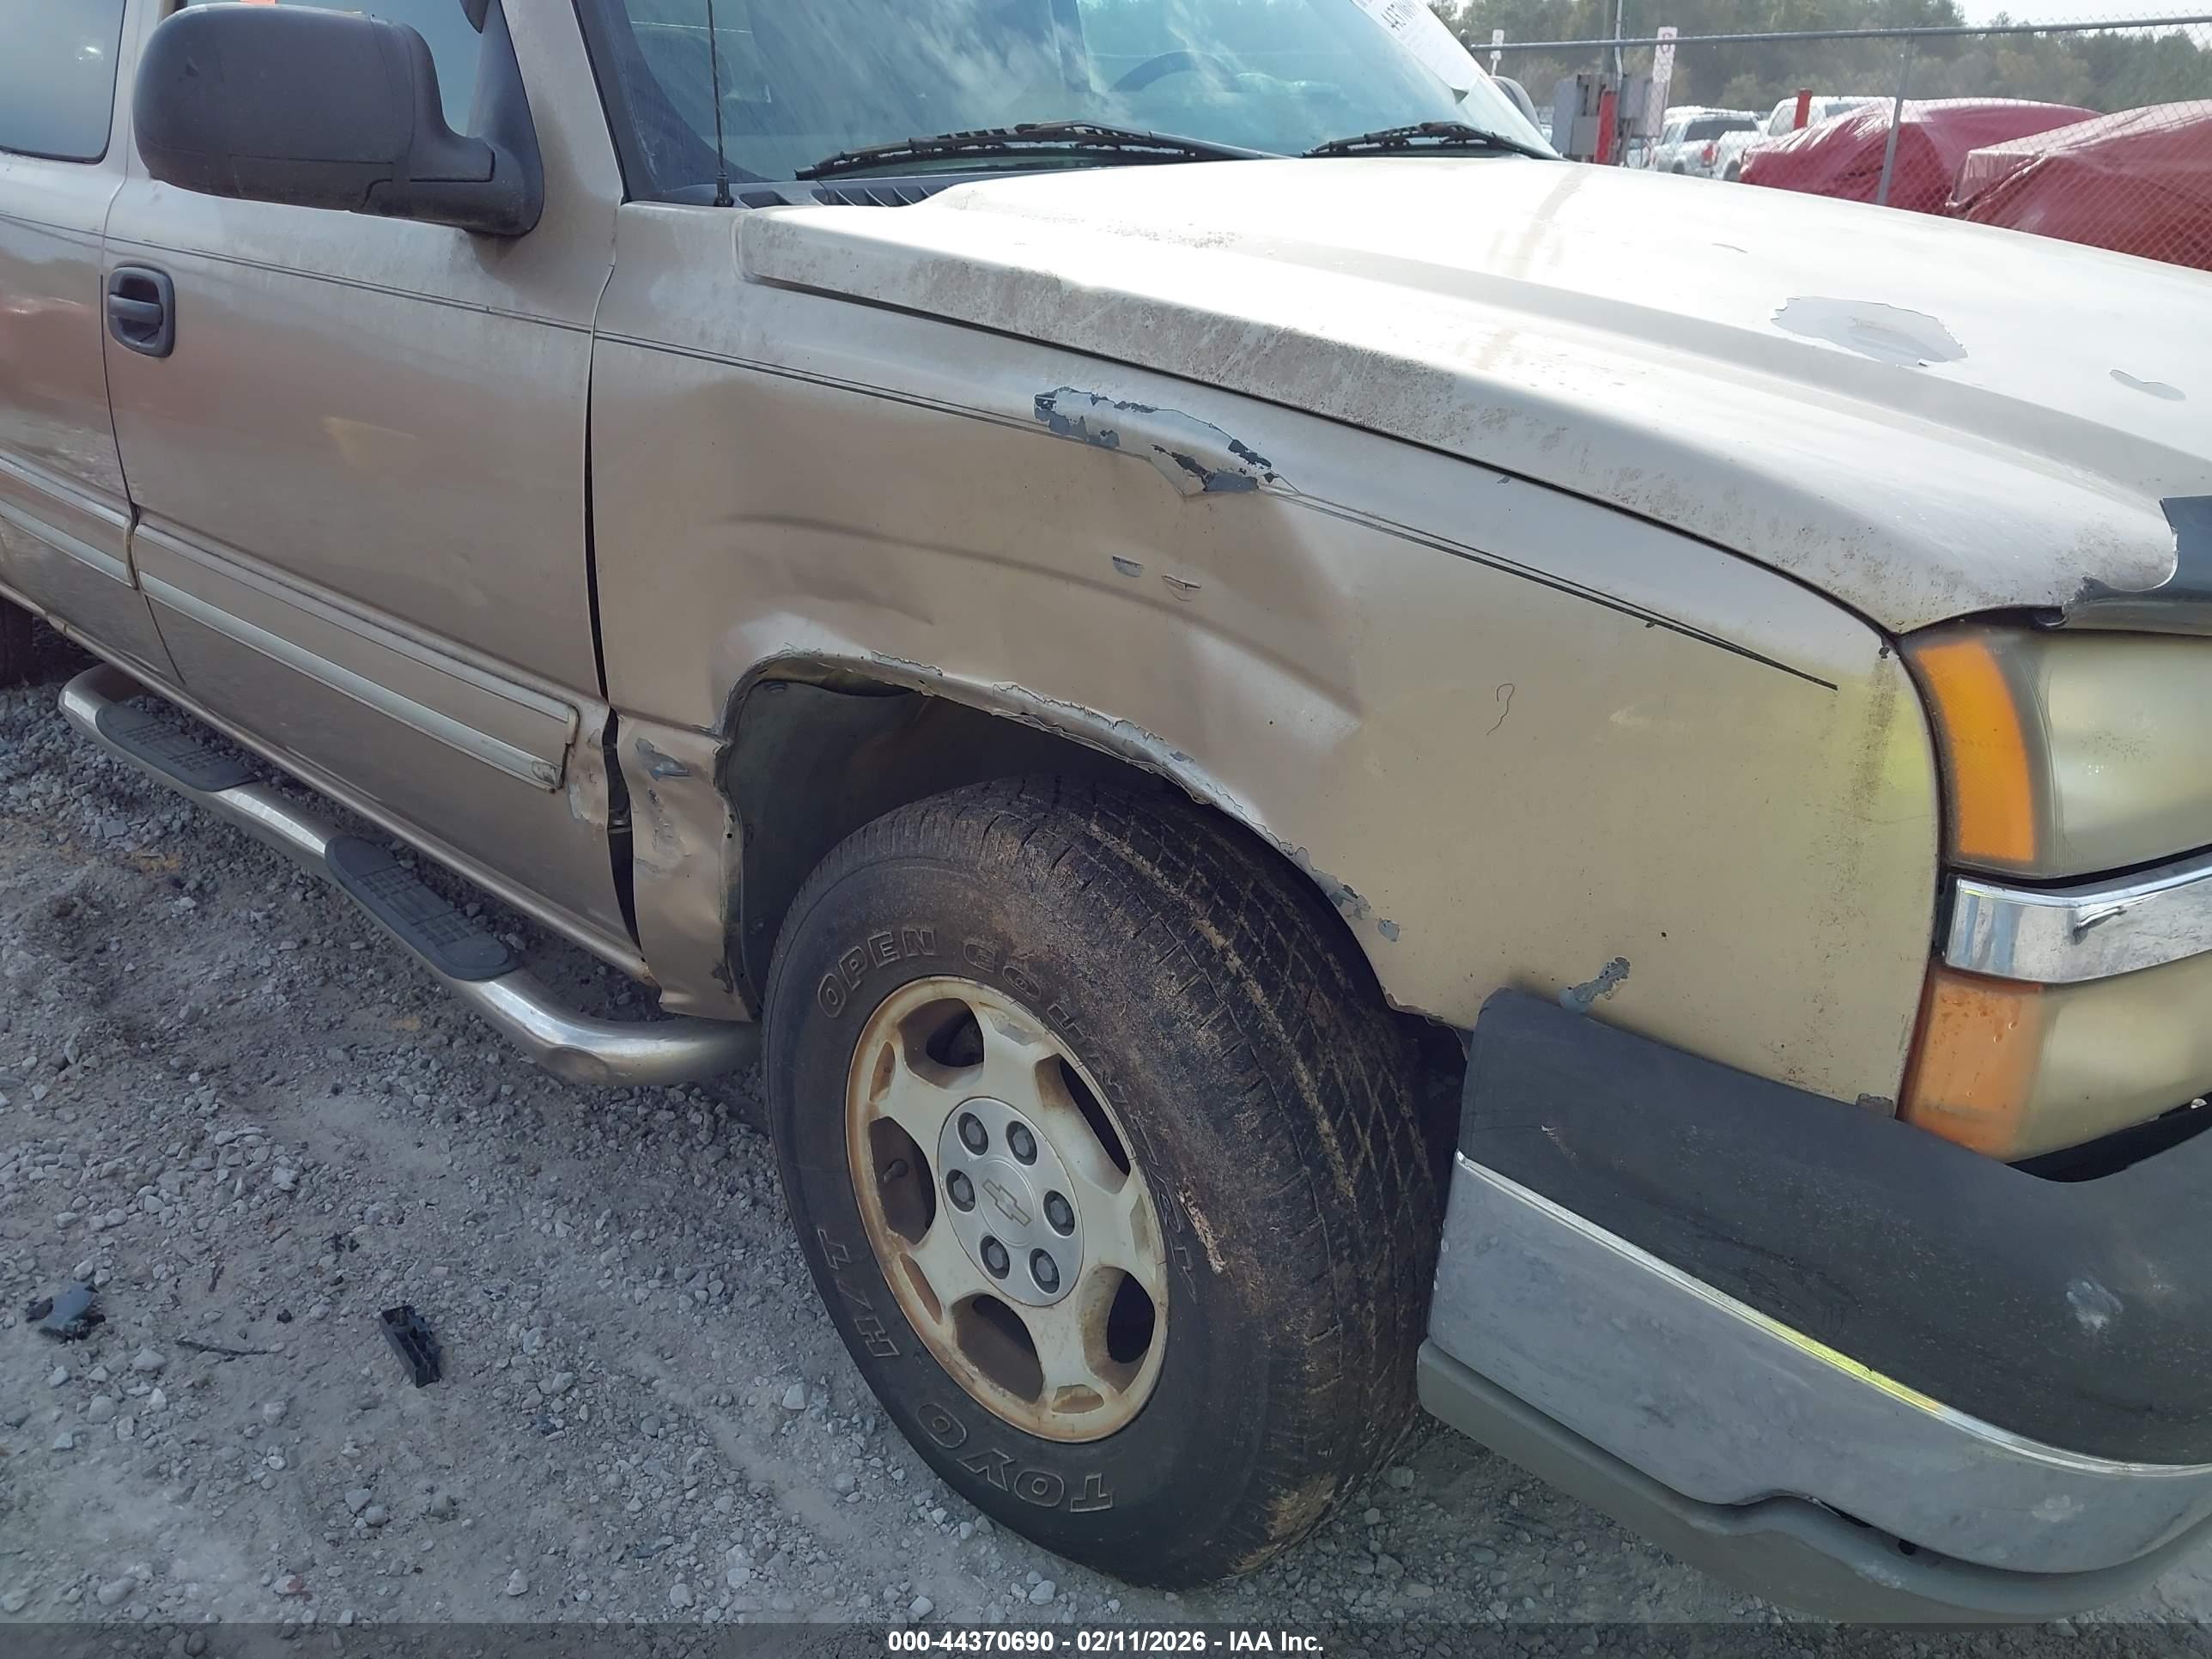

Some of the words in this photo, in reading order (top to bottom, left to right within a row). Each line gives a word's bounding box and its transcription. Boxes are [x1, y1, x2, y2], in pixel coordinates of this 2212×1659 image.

[817, 925, 938, 1018] OPEN
[963, 939, 1198, 1304] COURY
[916, 1402, 1114, 1513] TOYO
